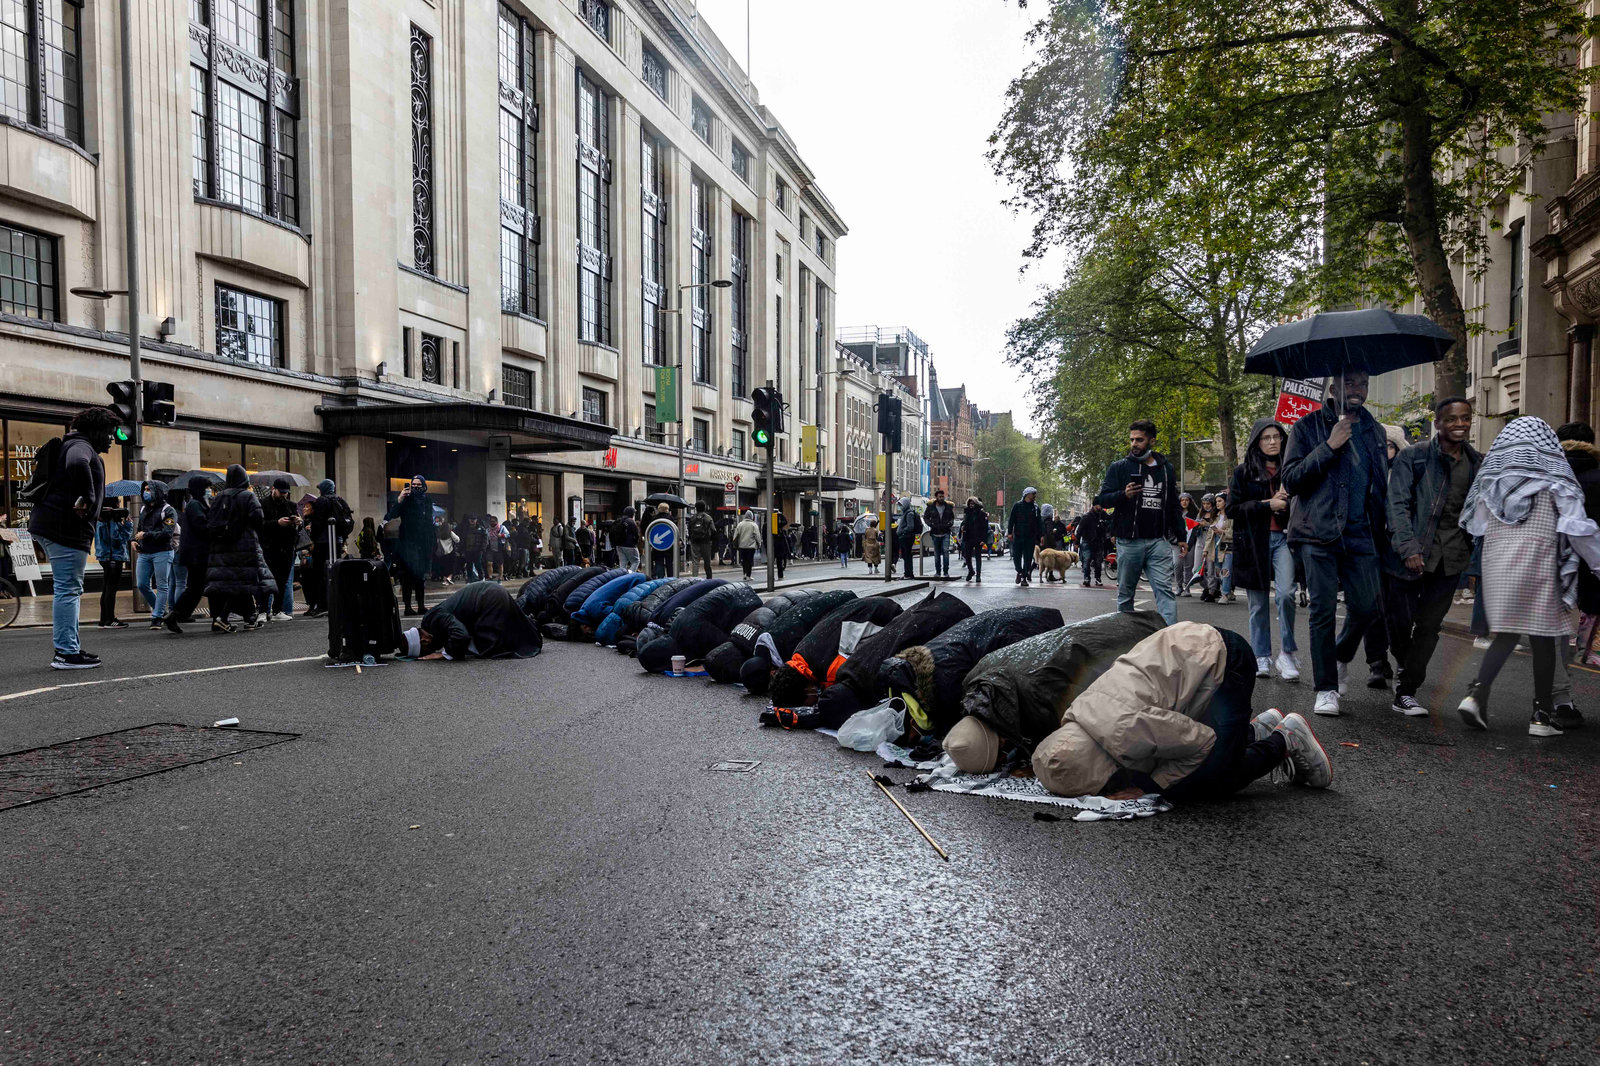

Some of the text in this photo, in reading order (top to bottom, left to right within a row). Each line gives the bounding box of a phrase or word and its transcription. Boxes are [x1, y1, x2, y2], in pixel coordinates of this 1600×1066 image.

[1283, 380, 1323, 402] PALESTINE
[15, 444, 39, 459] MAK
[1142, 498, 1161, 508] idas
